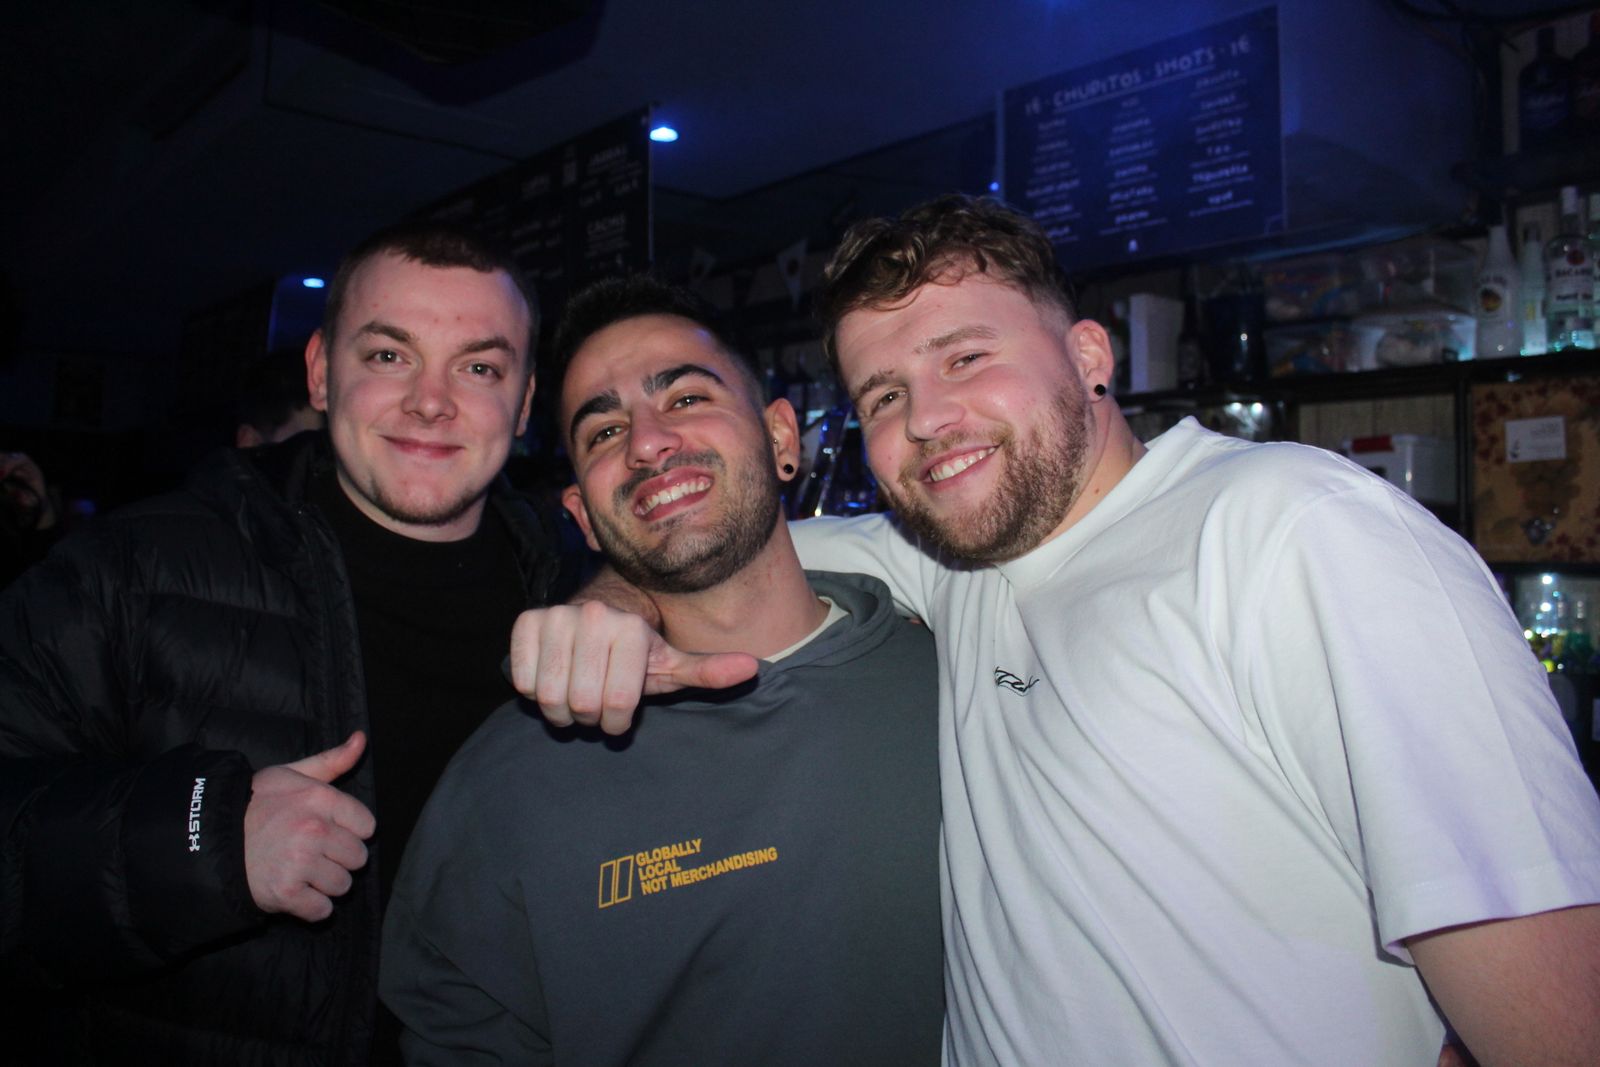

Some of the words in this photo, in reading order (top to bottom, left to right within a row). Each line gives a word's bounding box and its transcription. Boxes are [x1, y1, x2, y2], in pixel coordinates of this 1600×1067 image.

[1053, 68, 1141, 107] CHUPITOS
[1155, 46, 1216, 77] SHOTS
[188, 777, 206, 833] STORM
[635, 838, 702, 867] GLOBALLY
[637, 859, 682, 881] LOCAL
[640, 876, 669, 896] NOT
[670, 846, 778, 888] MERCHANDISING
